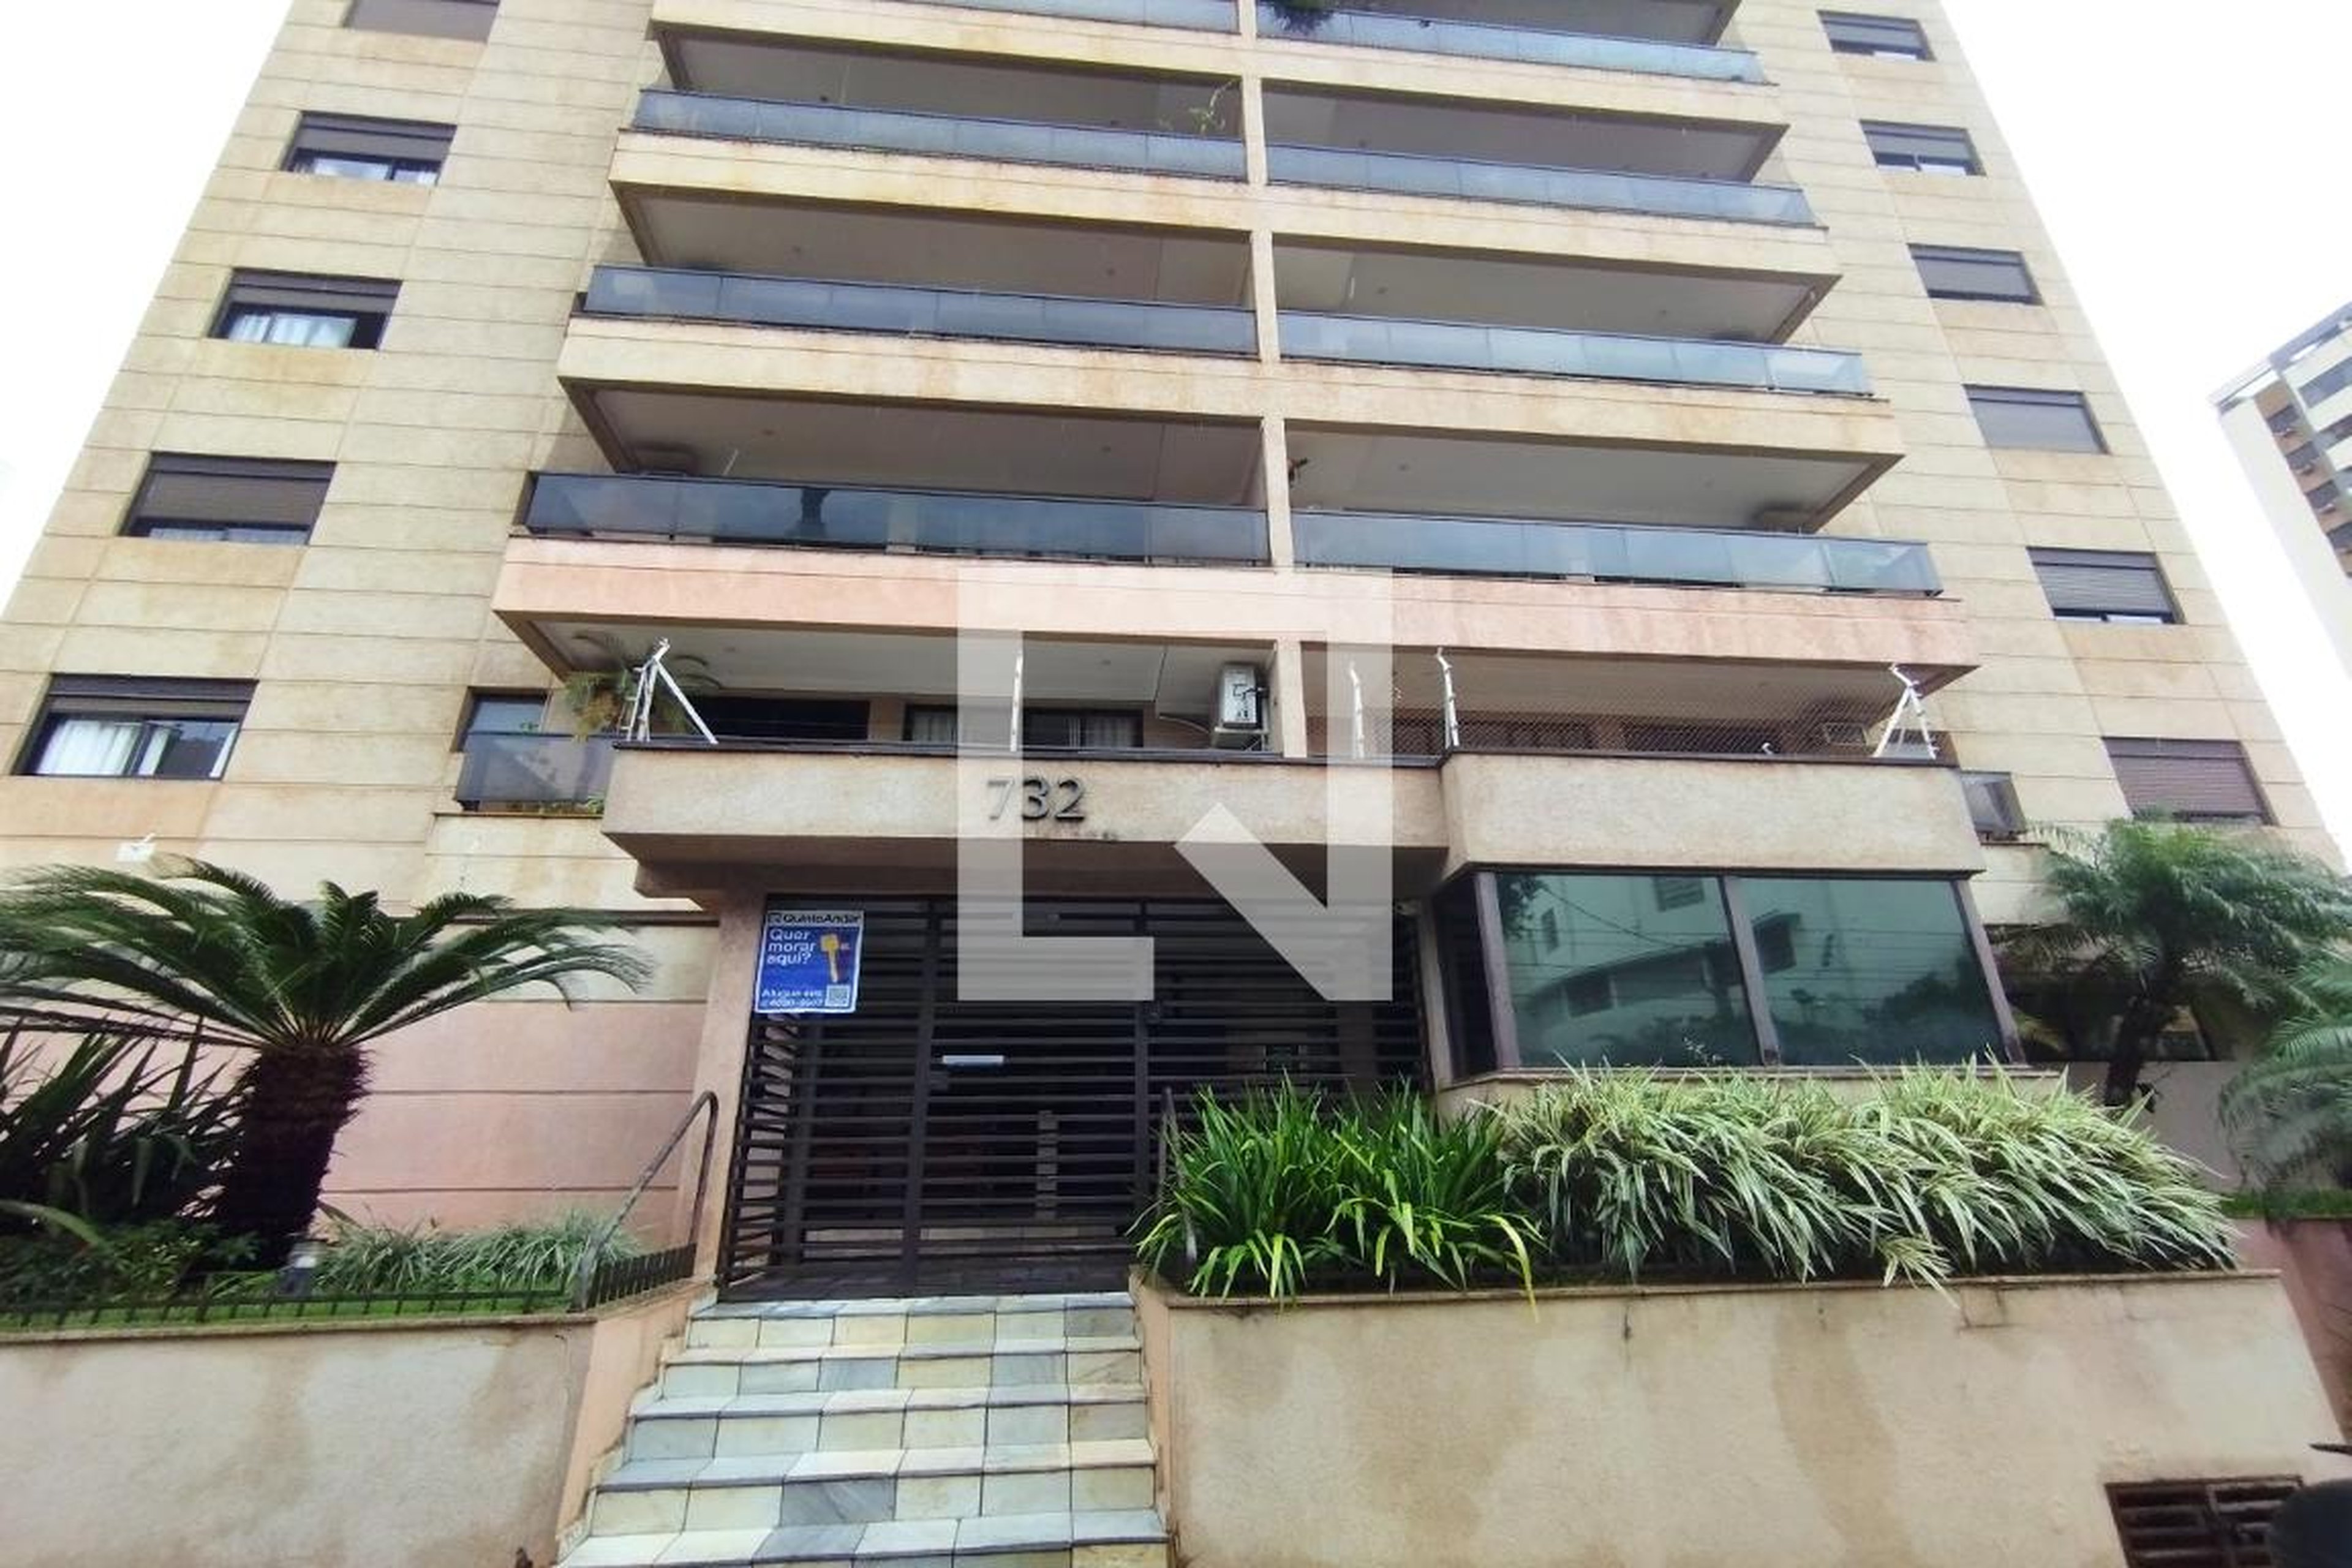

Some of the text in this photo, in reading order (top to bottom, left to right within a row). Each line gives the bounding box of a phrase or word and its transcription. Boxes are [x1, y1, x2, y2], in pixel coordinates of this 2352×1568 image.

[987, 776, 1086, 822] 732
[769, 929, 810, 941] Quer
[768, 942, 816, 952] morar
[766, 951, 812, 966] aqui?
